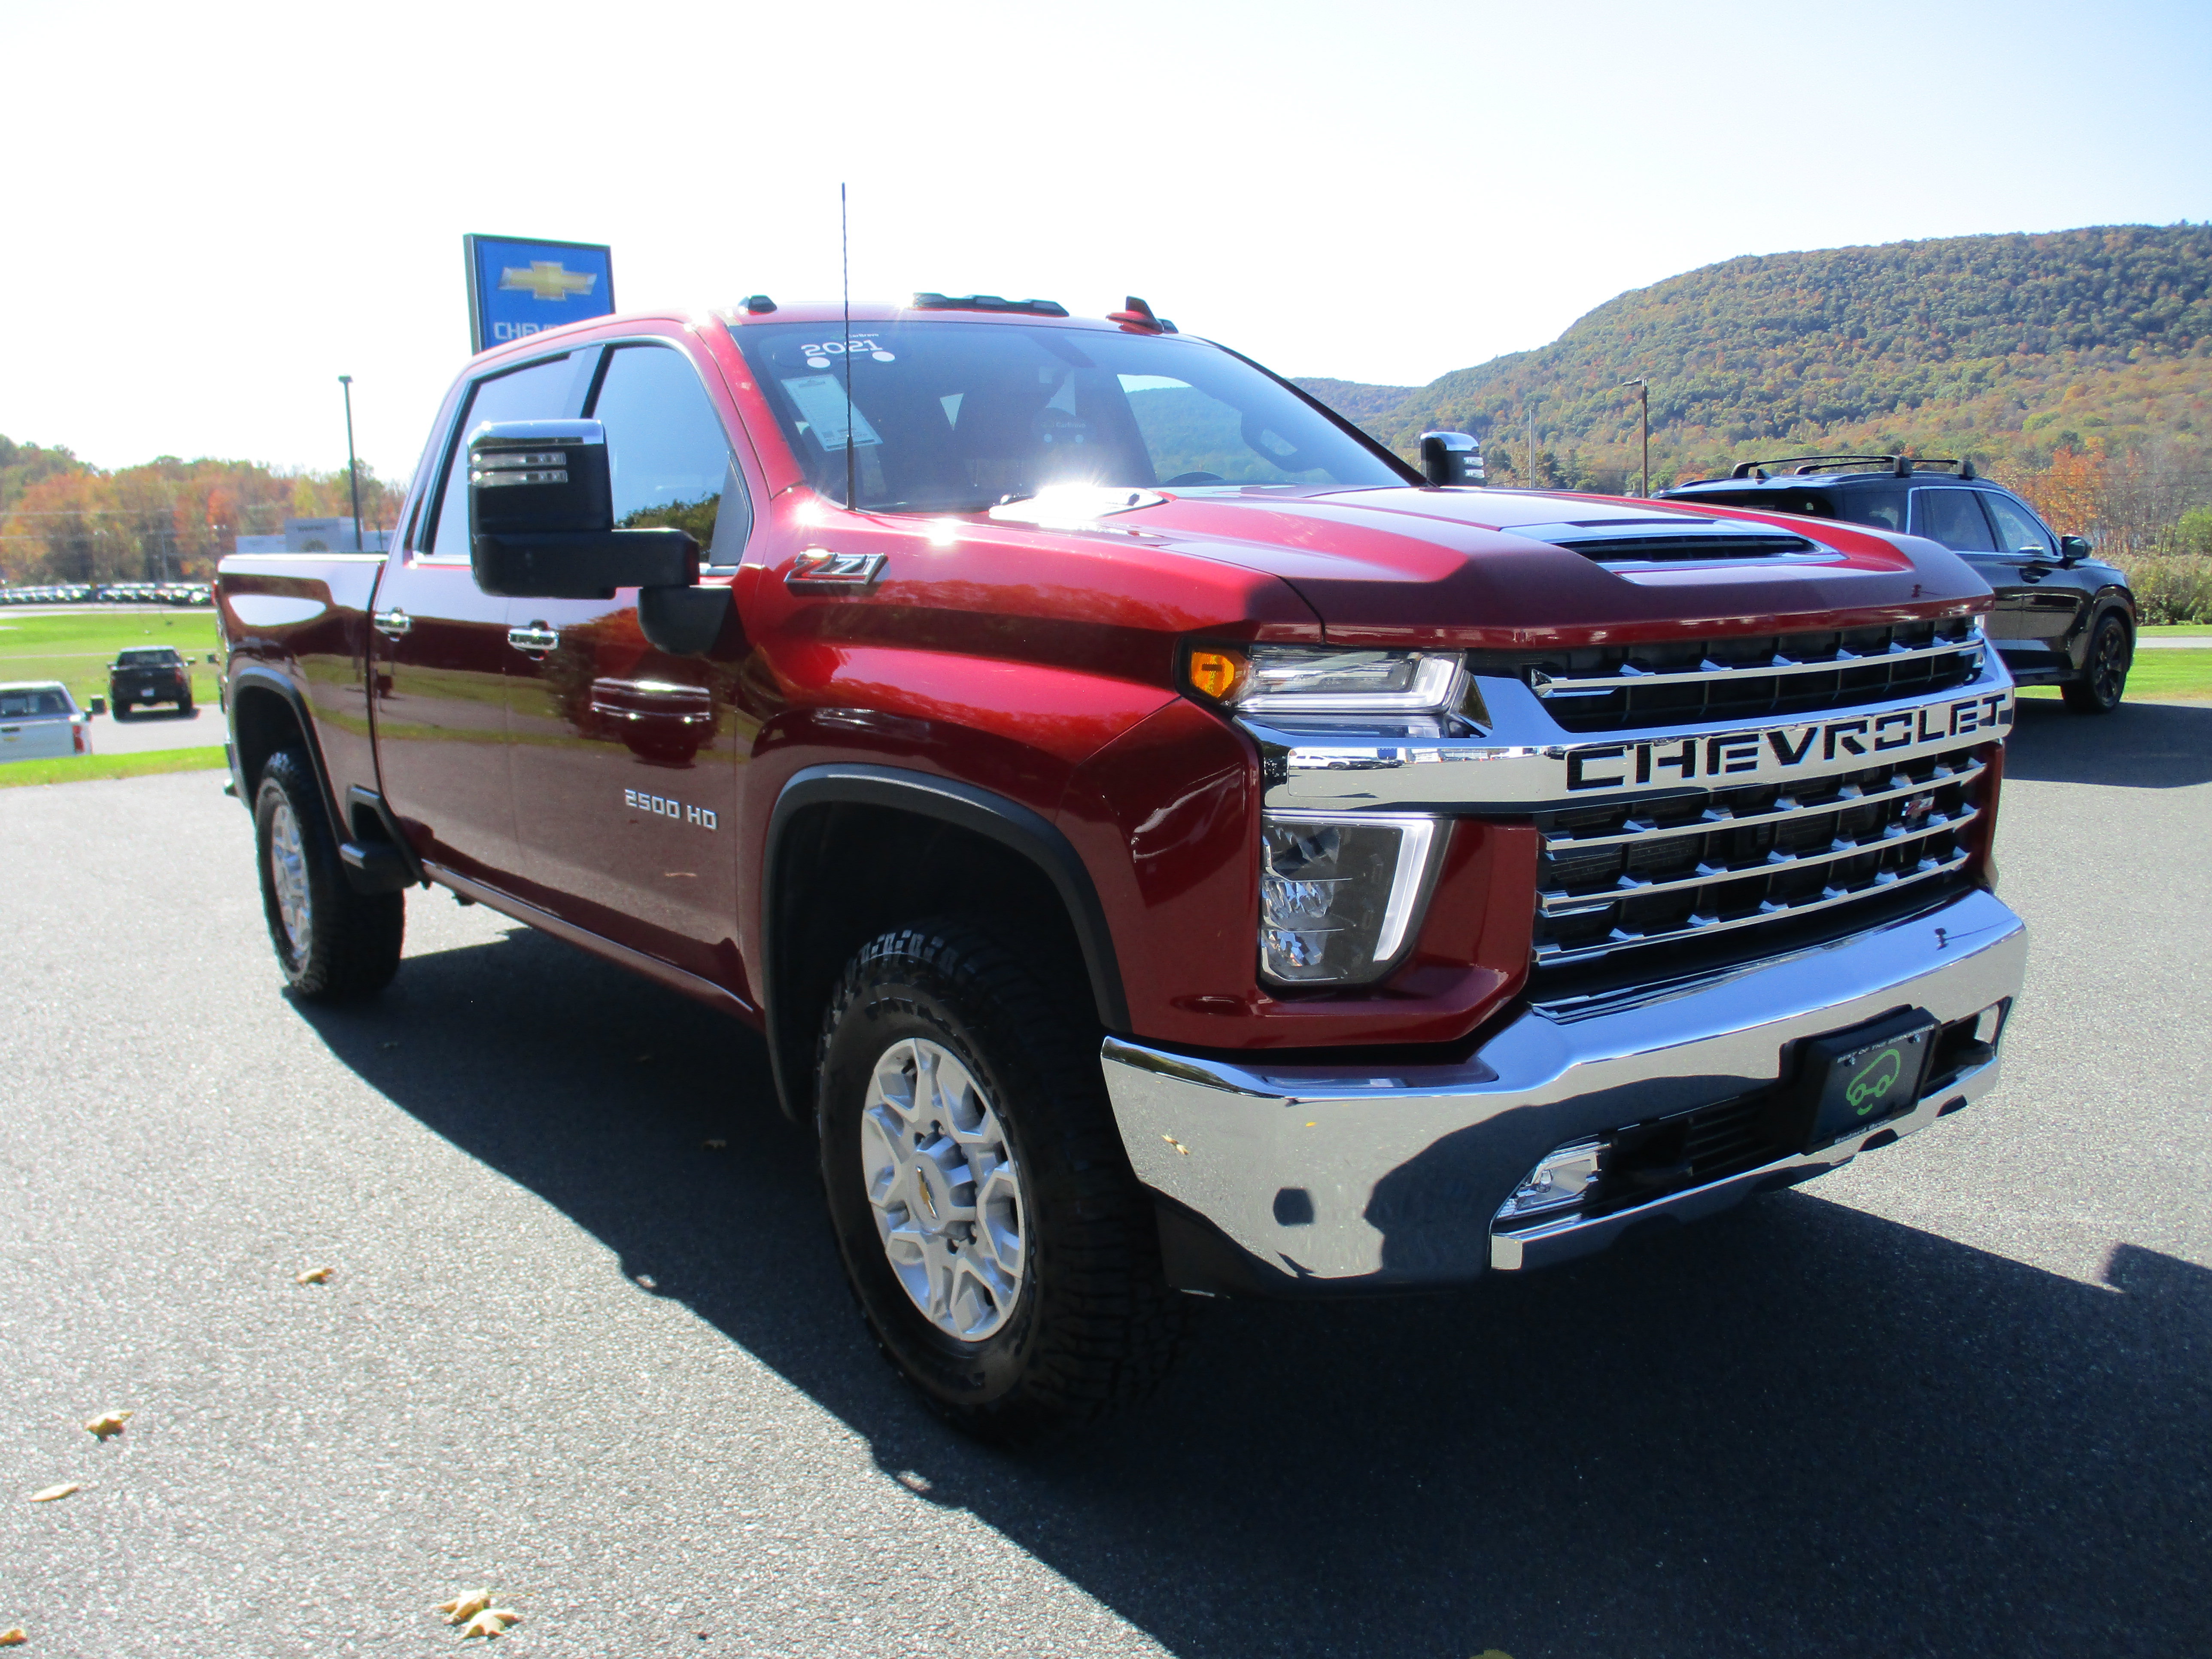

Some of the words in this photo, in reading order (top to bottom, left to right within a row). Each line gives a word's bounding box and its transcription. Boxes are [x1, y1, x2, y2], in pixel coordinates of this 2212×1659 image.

[801, 340, 883, 357] 2021
[1566, 693, 2008, 792] CHEVROLET
[624, 788, 681, 819] 2500
[687, 804, 717, 830] HD
